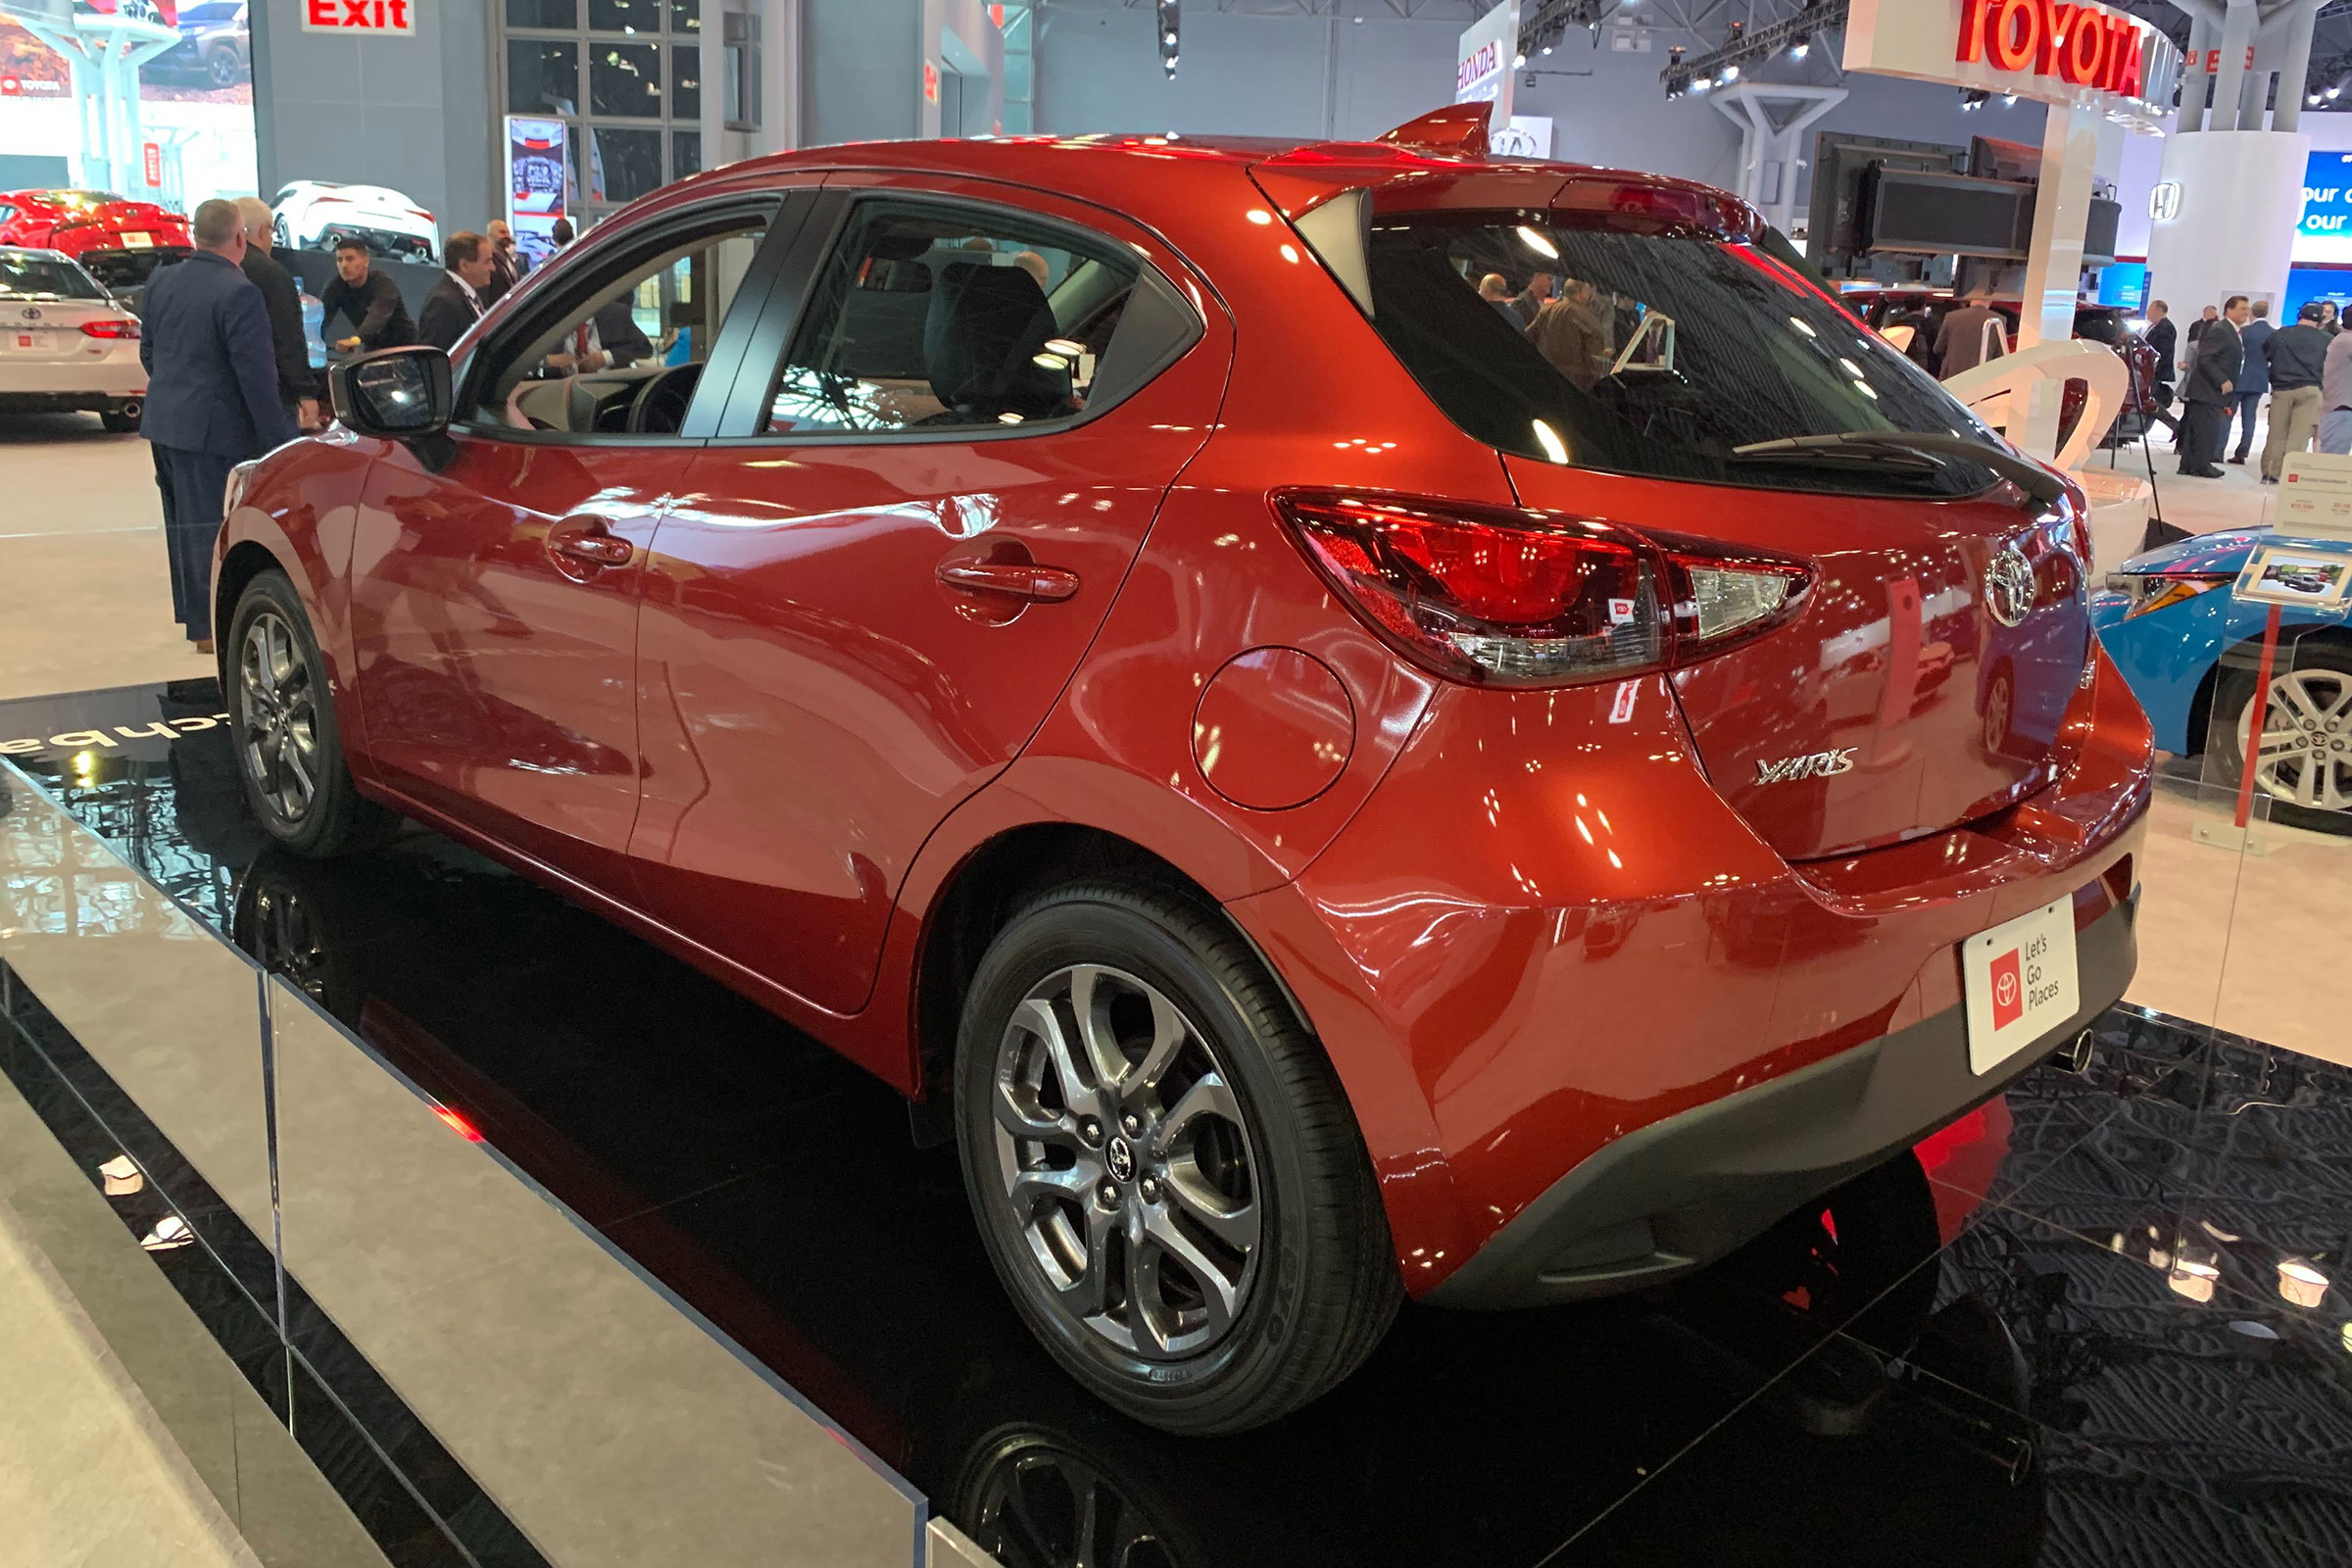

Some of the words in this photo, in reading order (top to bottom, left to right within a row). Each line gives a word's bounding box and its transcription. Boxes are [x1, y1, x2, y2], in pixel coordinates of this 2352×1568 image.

[308, 0, 408, 28] Exit
[1956, 0, 2141, 98] TOYOTA
[1457, 41, 1495, 91] HONDA
[1754, 747, 1859, 786] YARIS
[2025, 933, 2047, 961] Let's
[2027, 964, 2042, 986] Go
[2029, 980, 2060, 1011] Places
